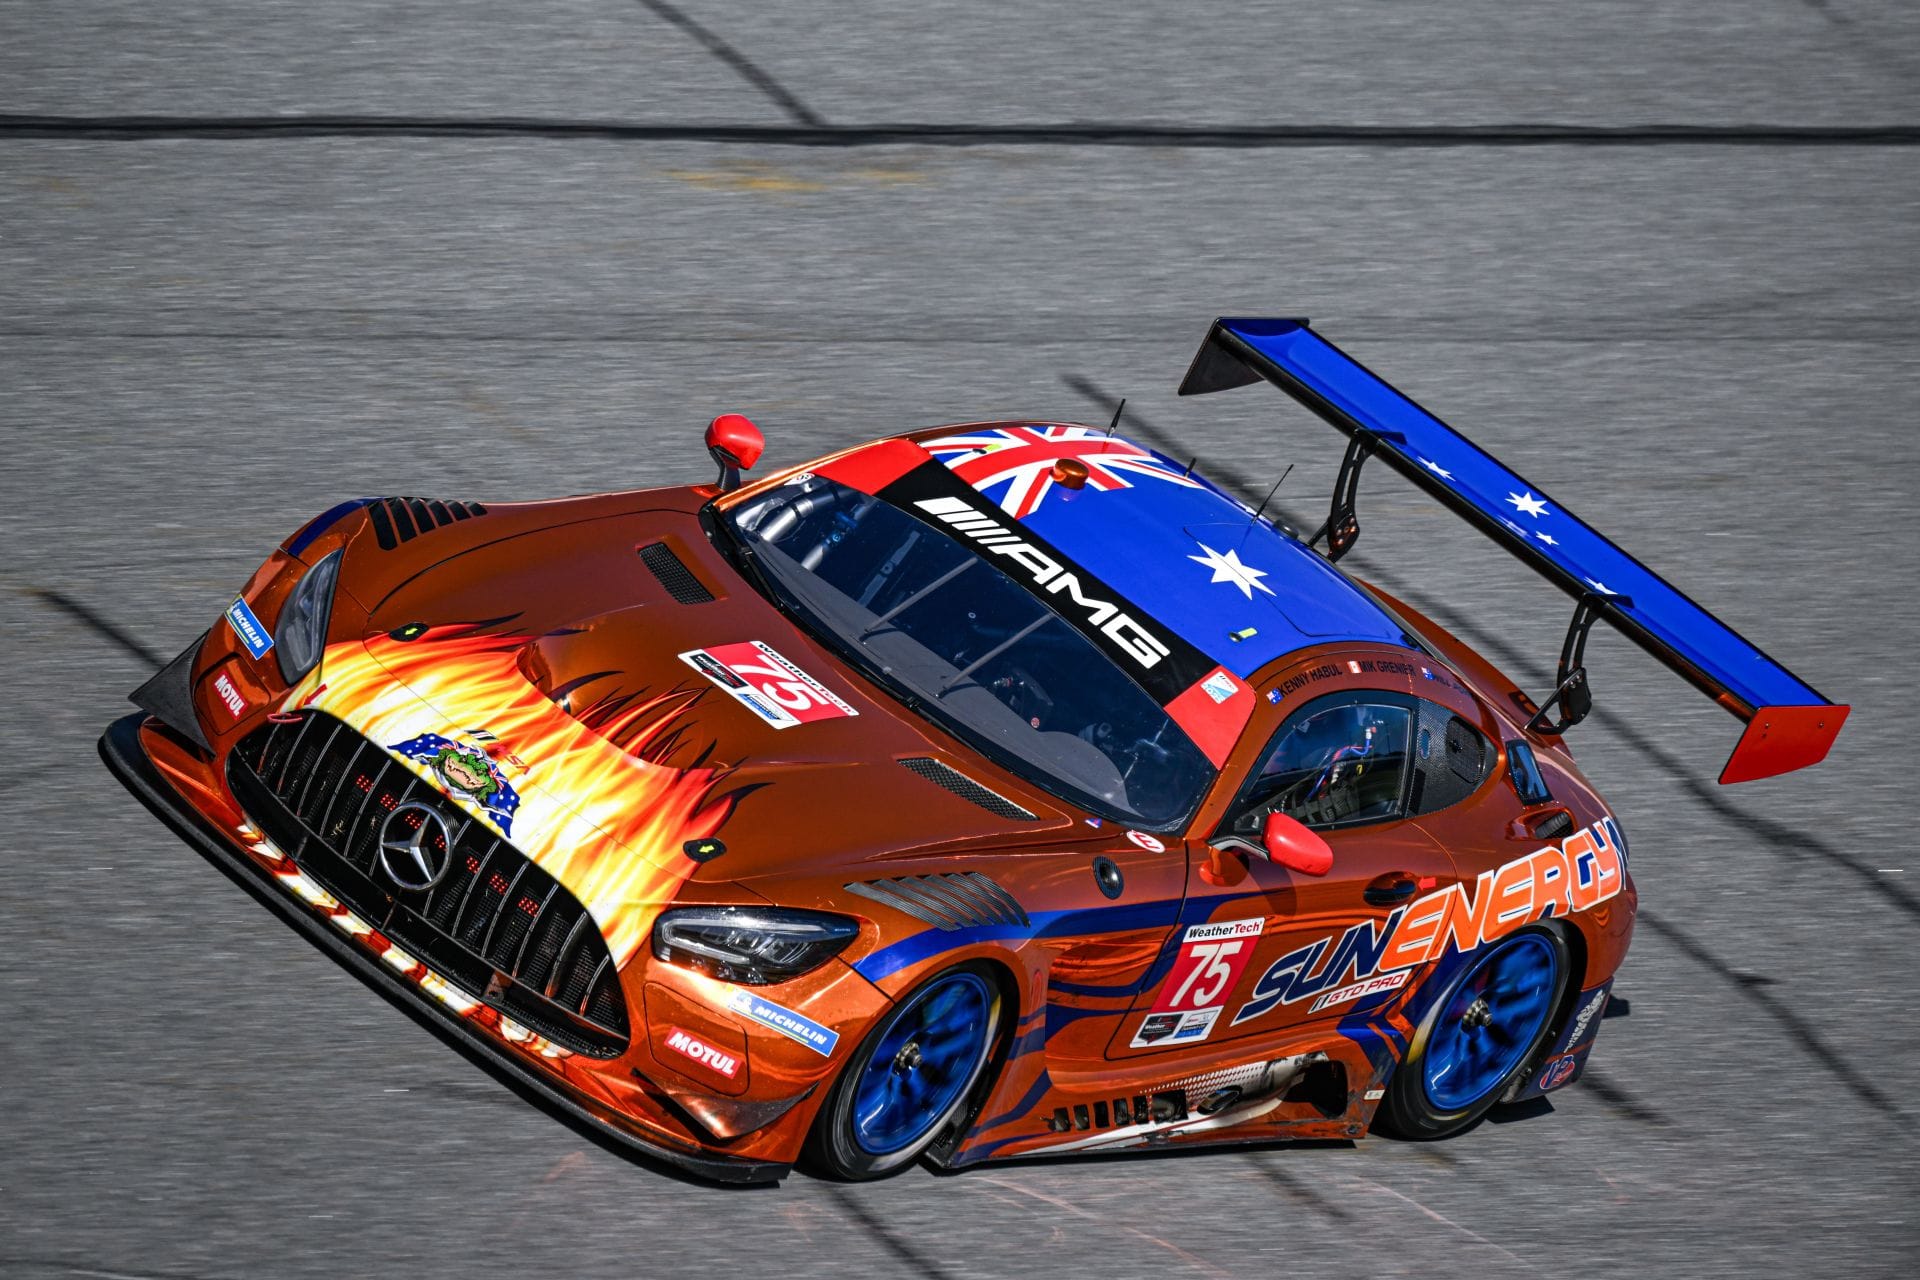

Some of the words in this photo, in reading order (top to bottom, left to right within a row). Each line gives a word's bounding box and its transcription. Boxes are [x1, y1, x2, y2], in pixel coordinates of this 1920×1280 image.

[987, 543, 1171, 669] AMG
[232, 608, 265, 649] MICHELIN
[728, 654, 831, 711] 75
[758, 643, 853, 713] WeatherTech
[1278, 675, 1309, 697] KENNY
[1311, 664, 1343, 682] HABUL
[1360, 661, 1377, 673] MIK
[1377, 661, 1416, 676] GRENIER
[214, 674, 245, 717] MOTUL
[1188, 923, 1260, 939] WeatherTech
[1169, 940, 1244, 1007] 75
[1365, 974, 1404, 993] PRO
[754, 1005, 828, 1045] MICHELIN
[668, 1031, 736, 1075] MOTUL
